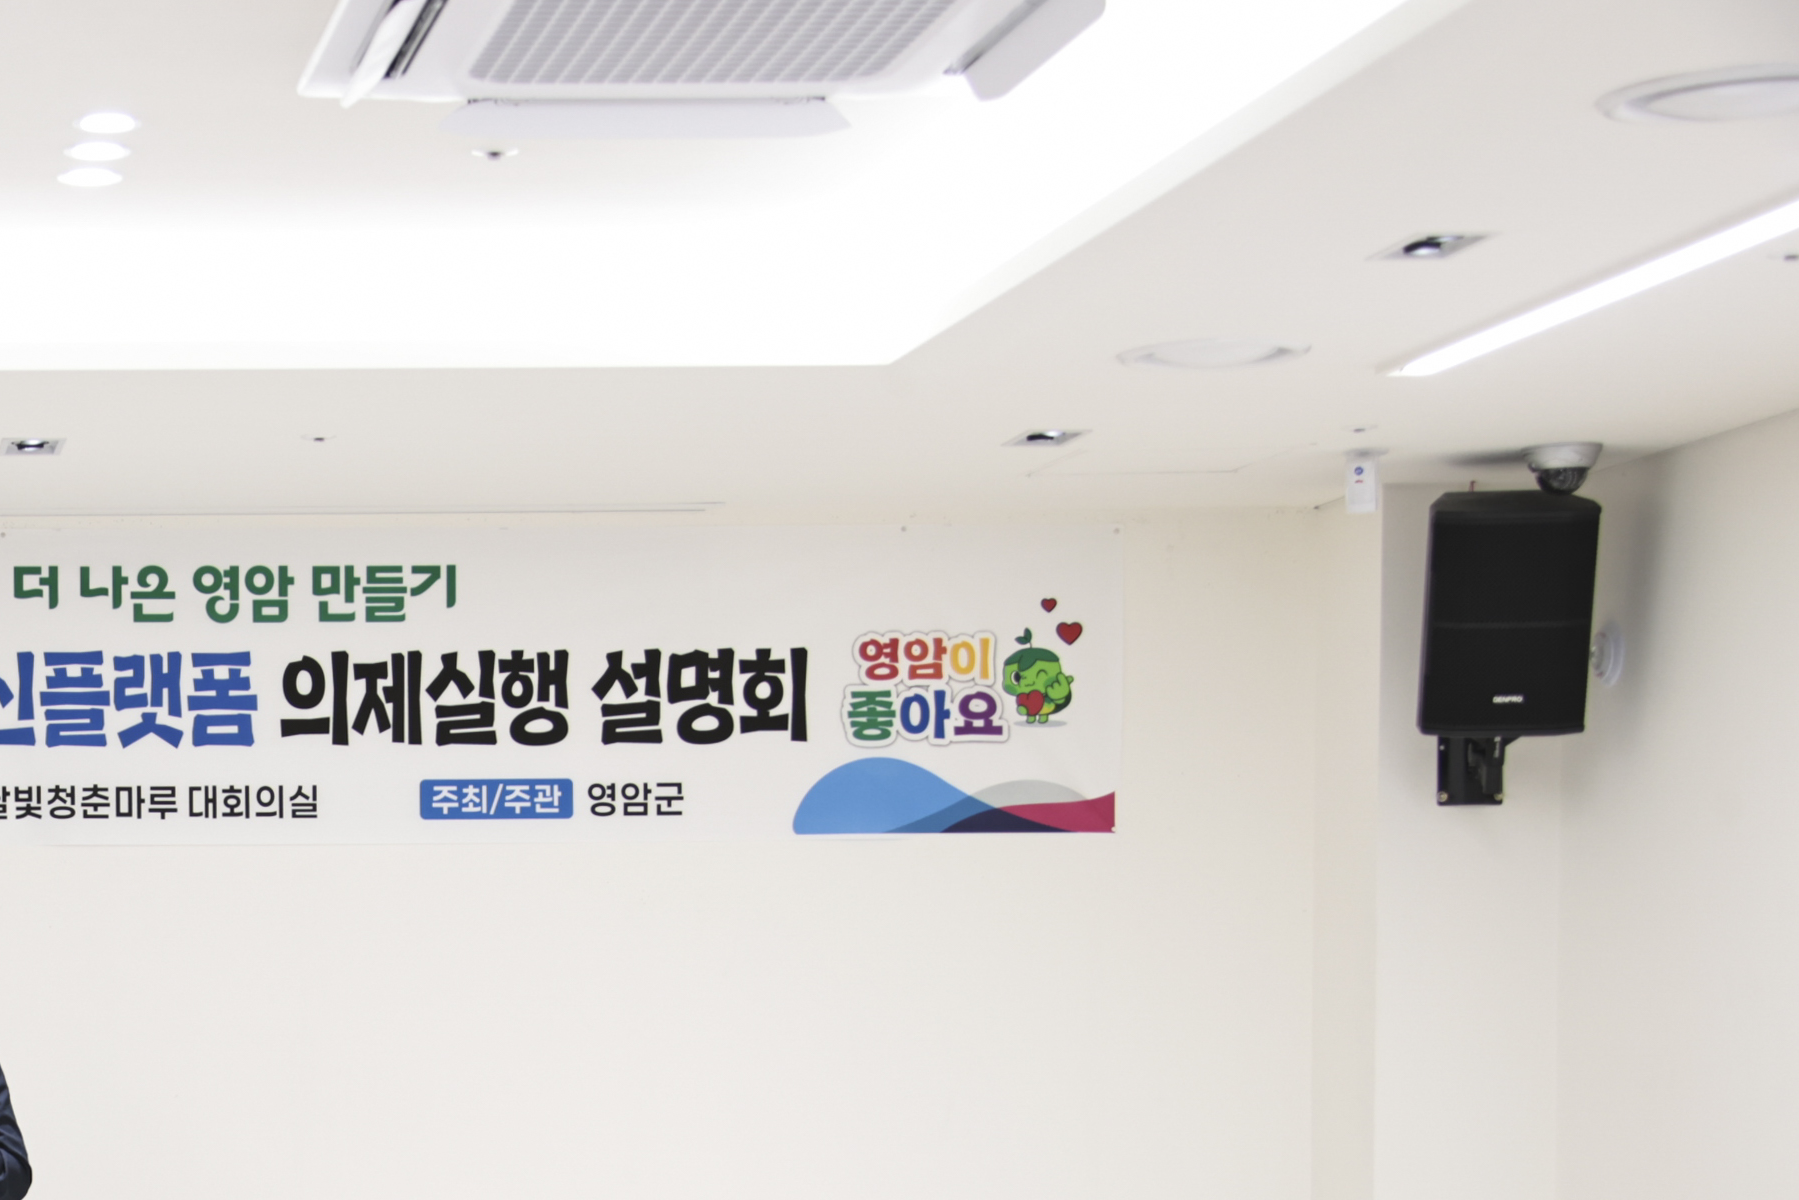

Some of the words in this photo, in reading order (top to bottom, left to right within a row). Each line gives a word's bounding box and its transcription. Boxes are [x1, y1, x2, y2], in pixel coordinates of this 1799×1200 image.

[13, 564, 60, 610] 더
[79, 564, 177, 624] 나은
[192, 564, 296, 625] 영암
[311, 563, 457, 624] 만들기
[858, 637, 991, 681] 영암이
[279, 648, 570, 747] 의제실행
[590, 646, 809, 746] 설명회
[847, 689, 1004, 742] 좋아요
[188, 784, 318, 820] 대회의실
[431, 783, 563, 816] 주최/주관
[587, 781, 685, 818] 영암군
